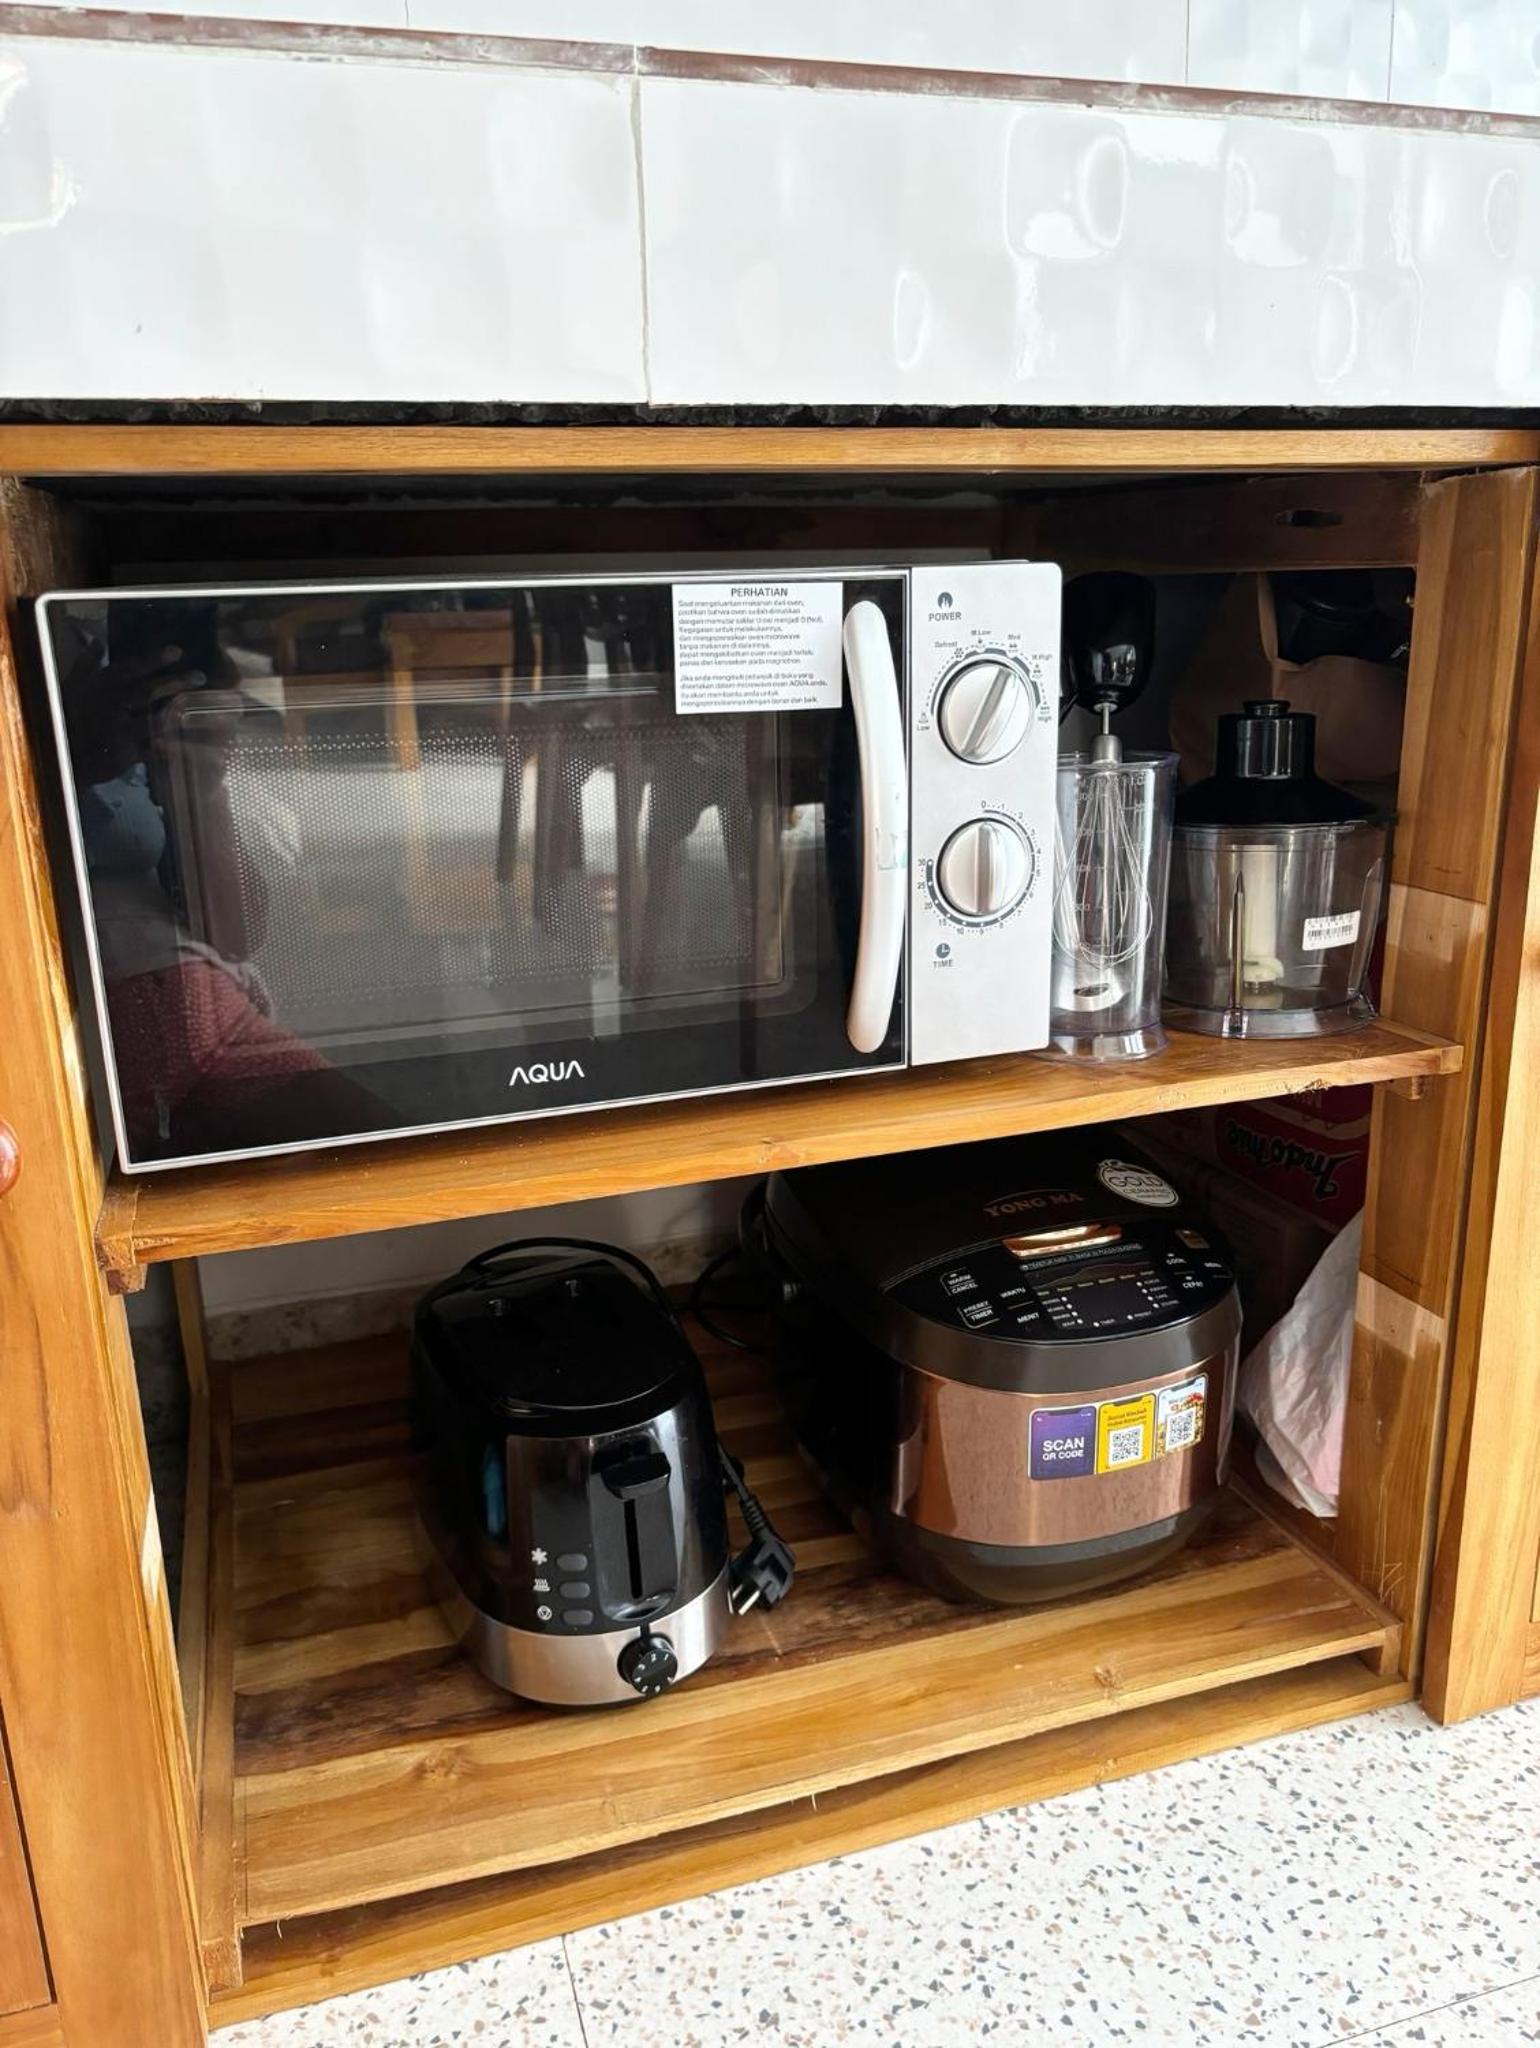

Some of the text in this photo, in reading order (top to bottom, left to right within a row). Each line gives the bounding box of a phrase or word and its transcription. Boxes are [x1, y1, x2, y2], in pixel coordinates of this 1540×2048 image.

[731, 587, 788, 597] PERHATIAN
[928, 612, 962, 622] POWER
[933, 959, 953, 968] TIME
[509, 1060, 585, 1086] AQUA
[1108, 1174, 1164, 1188] GOLD
[983, 1196, 1047, 1217] YONG
[951, 1282, 978, 1294] CANCEL
[970, 1309, 994, 1322] TIMER
[1043, 1437, 1085, 1453] SCAN
[1043, 1450, 1084, 1461] QR CODE
